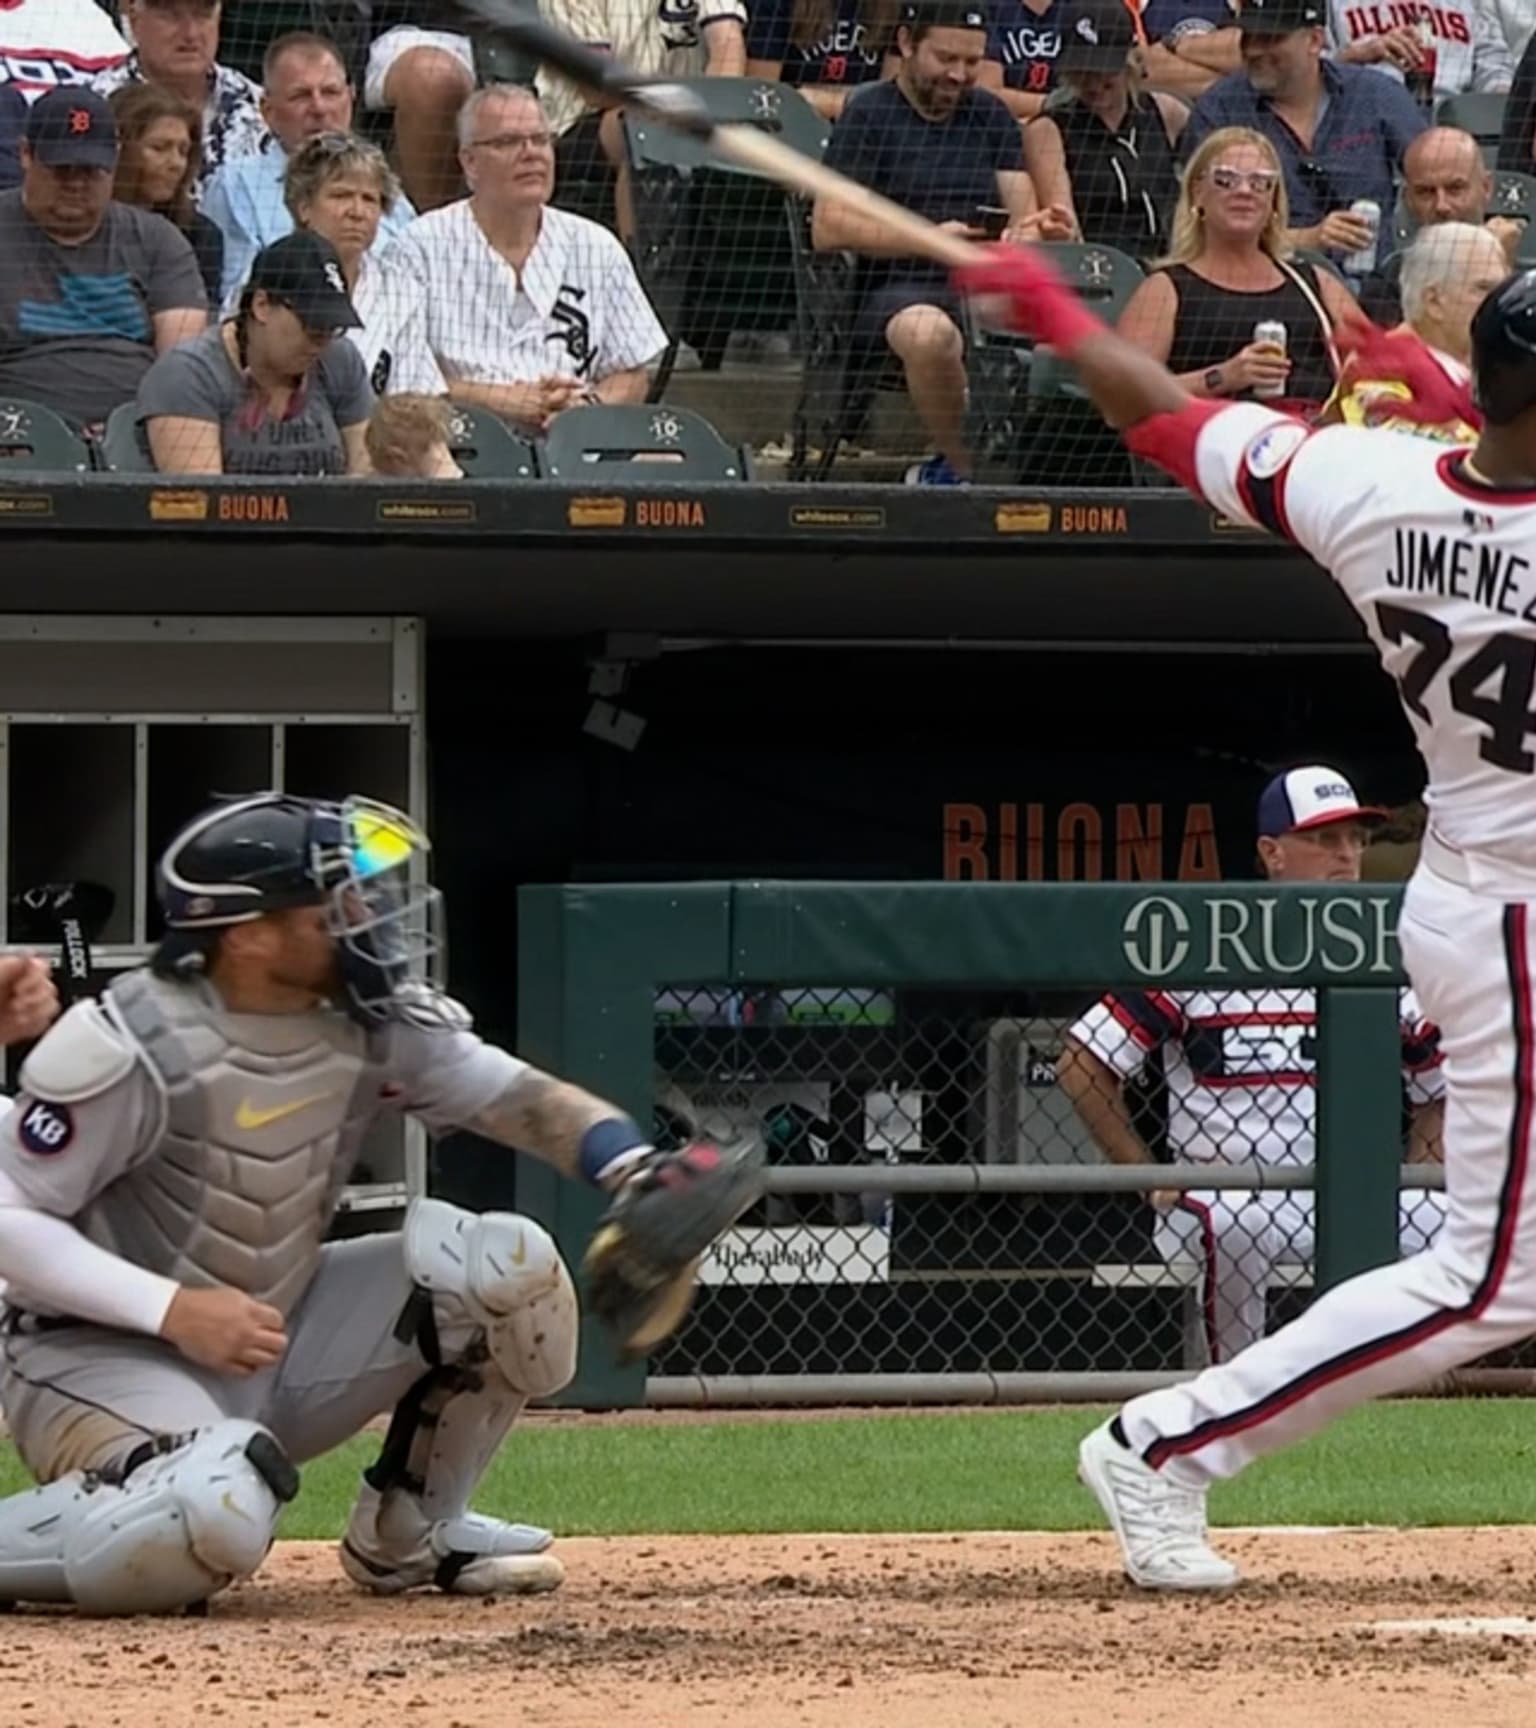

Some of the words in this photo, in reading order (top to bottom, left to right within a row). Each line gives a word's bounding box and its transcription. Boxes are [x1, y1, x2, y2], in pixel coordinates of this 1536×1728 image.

[218, 495, 290, 522] BUONA
[382, 504, 471, 518] whitesox.com
[635, 500, 705, 526] BUONA
[794, 510, 881, 525] whitesox.com
[1060, 506, 1127, 533] BUONA
